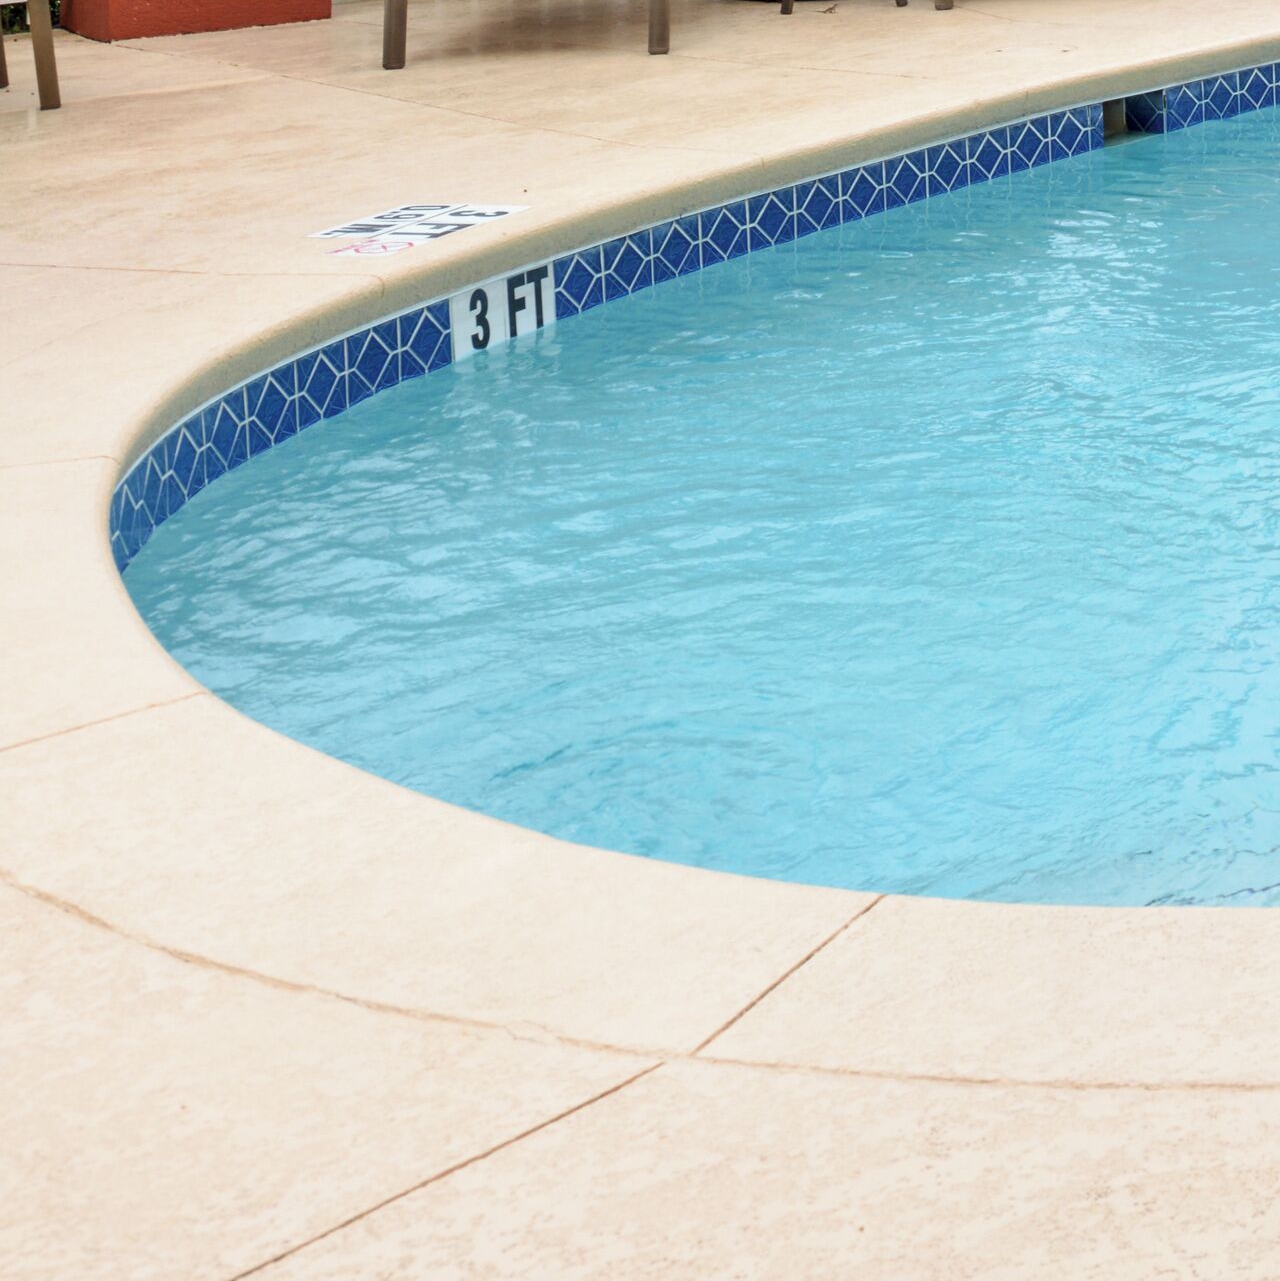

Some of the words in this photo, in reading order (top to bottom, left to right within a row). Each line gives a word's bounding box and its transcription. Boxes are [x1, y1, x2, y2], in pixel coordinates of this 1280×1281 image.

[448, 210, 509, 218] 3
[390, 222, 476, 239] FT
[469, 288, 491, 350] 3
[507, 265, 548, 338] FT
